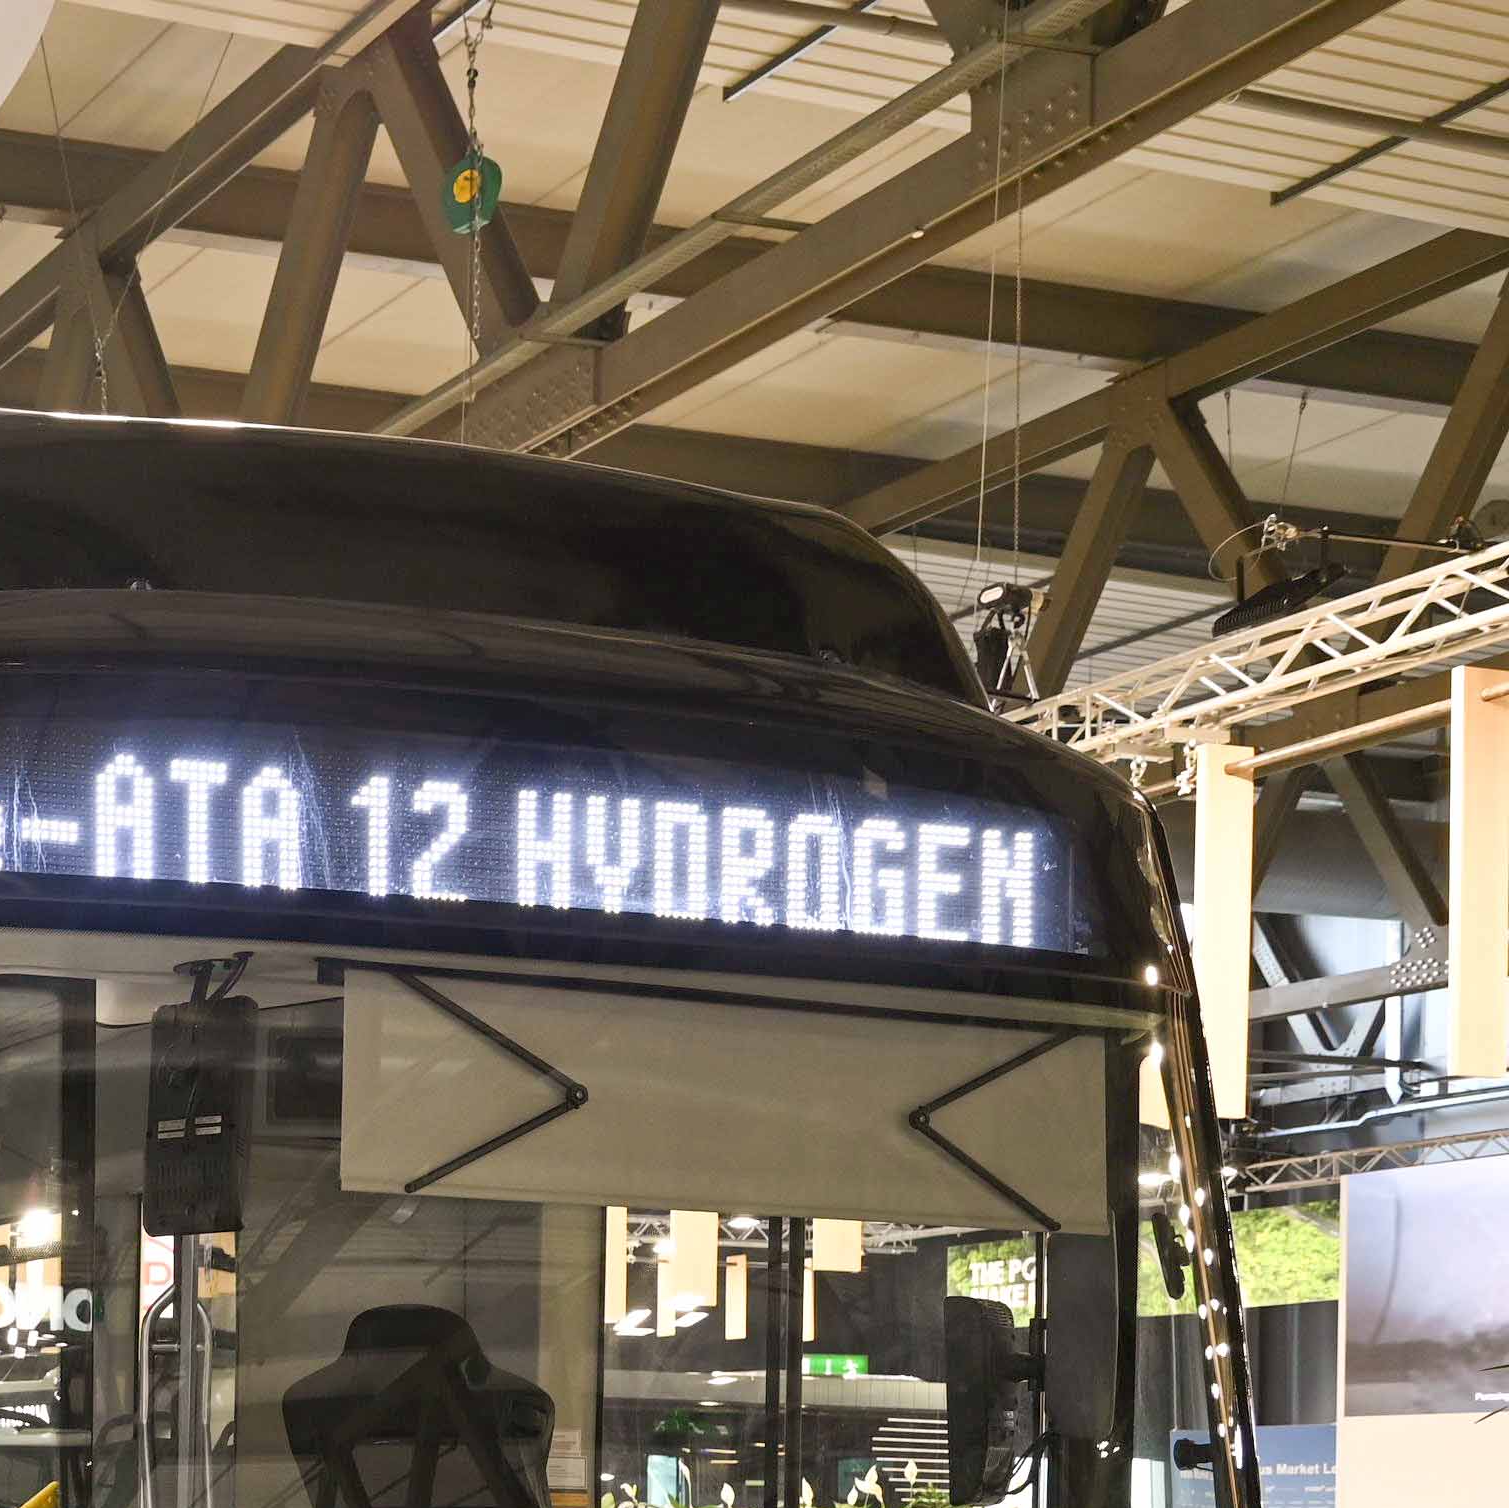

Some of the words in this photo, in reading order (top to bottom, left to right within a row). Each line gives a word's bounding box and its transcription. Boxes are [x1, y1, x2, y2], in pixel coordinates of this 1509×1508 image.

[352, 775, 468, 902] 12
[517, 788, 1034, 947] HYDROGEN
[968, 1260, 1005, 1285] THE
[1276, 1463, 1319, 1475] Market
